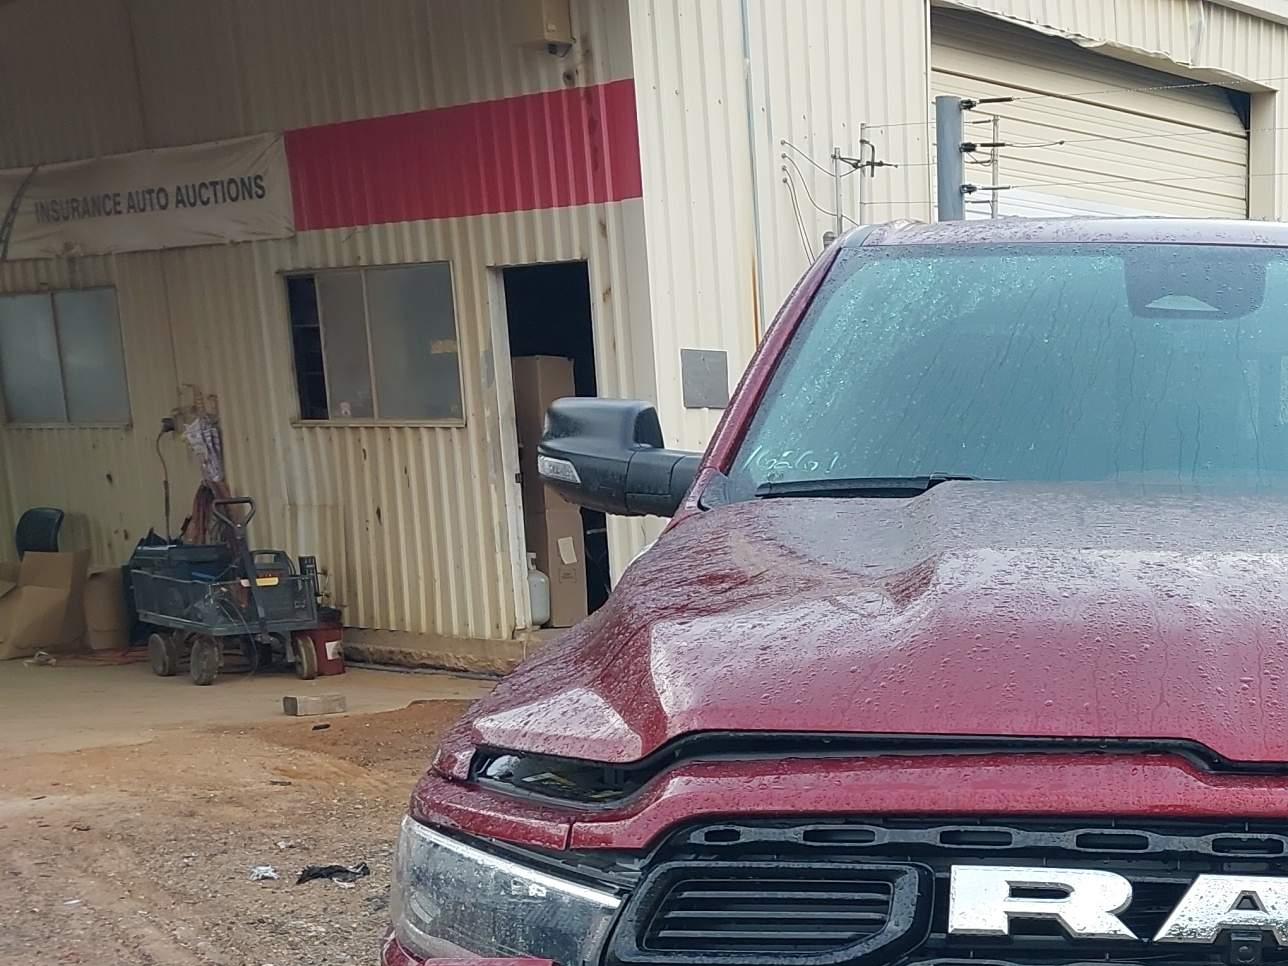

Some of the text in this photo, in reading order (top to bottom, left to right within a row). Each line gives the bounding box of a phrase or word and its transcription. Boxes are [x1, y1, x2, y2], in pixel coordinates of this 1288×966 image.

[34, 174, 267, 224] INSURANCE AUTO AUCTIONS
